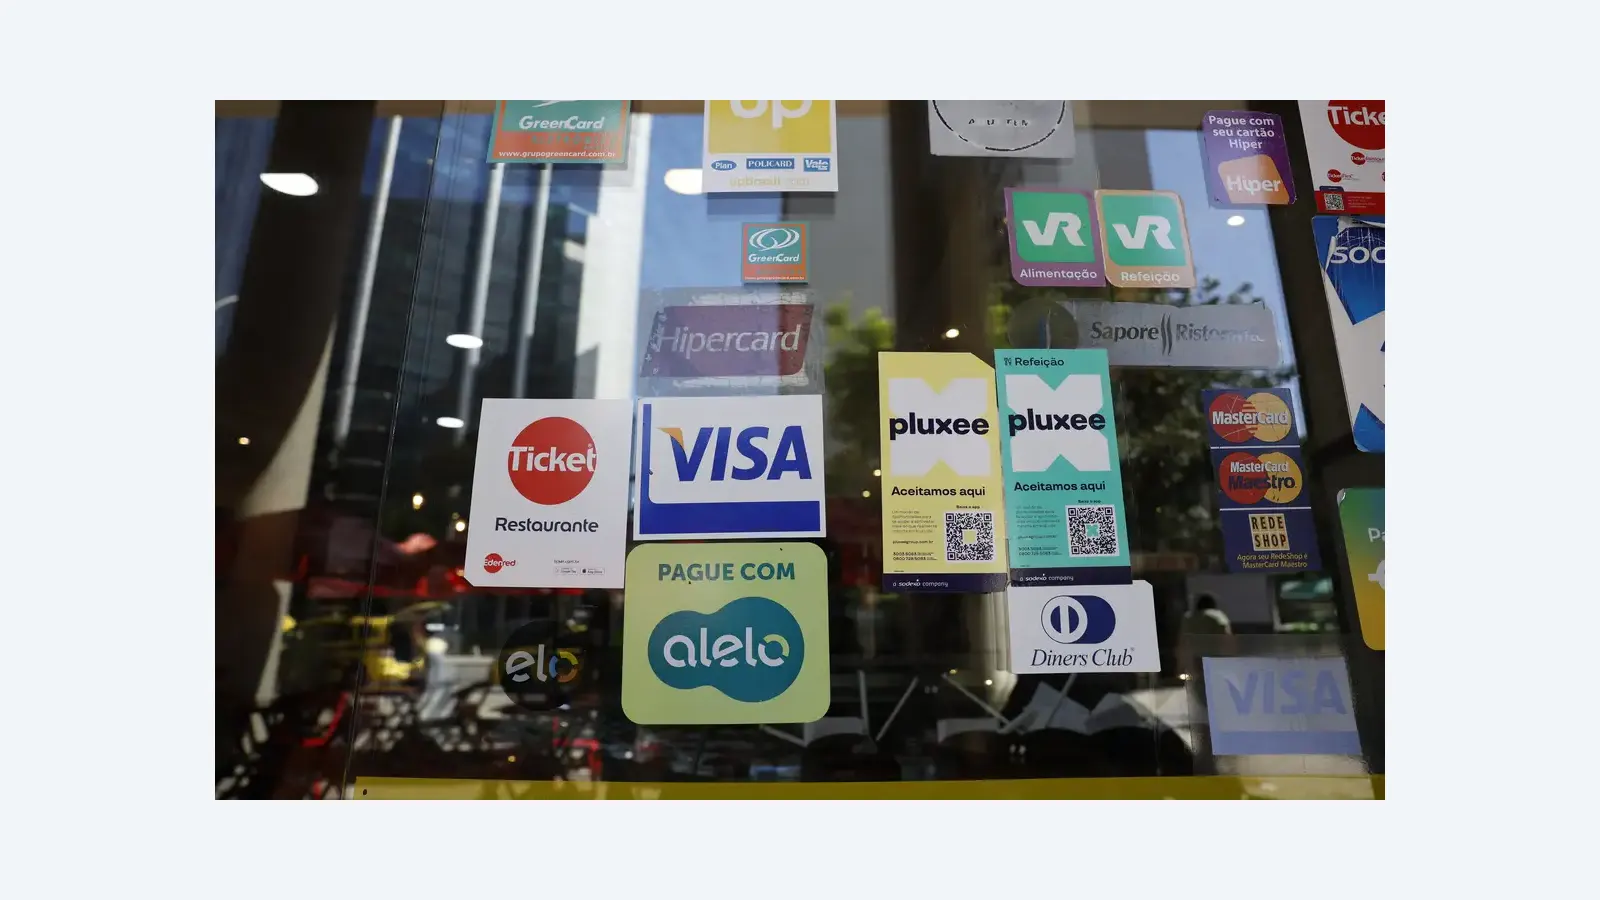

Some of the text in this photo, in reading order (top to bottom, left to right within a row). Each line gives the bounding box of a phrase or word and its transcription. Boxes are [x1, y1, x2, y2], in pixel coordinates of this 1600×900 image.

[518, 115, 605, 130] GreenCard
[1208, 115, 1274, 128] Pague com
[1213, 128, 1275, 138] seu cartão
[1229, 139, 1263, 150] Hiper
[748, 159, 793, 168] POLICARD
[1226, 175, 1281, 195] Hiper
[748, 253, 800, 263] GreenCard
[1020, 268, 1097, 281] Alimentação
[1121, 271, 1180, 283] Refeição
[1091, 321, 1159, 342] Sapore
[651, 324, 801, 360] Hipercard
[1014, 357, 1065, 368] Refeição
[1008, 408, 1106, 436] pluxee
[1212, 411, 1289, 425] MasterCard
[889, 412, 989, 441] pluxee
[508, 444, 597, 473] Ticket
[657, 425, 812, 482] VISA
[1230, 461, 1289, 473] MasterCard
[1014, 481, 1106, 493] Aceitamos aqui
[1228, 475, 1296, 491] Maestro
[891, 486, 985, 499] Aceitamos aqui
[495, 517, 599, 533] Restaurante
[1251, 516, 1285, 530] REDE
[1254, 534, 1287, 548] SHOP
[484, 559, 516, 567] Edenred
[1237, 554, 1257, 562] Agora
[1270, 552, 1303, 561] RedeShop
[658, 562, 795, 582] PAGUE COM
[1242, 561, 1279, 569] MasterCard
[663, 627, 790, 668] alelo
[505, 644, 579, 683] elo
[1031, 648, 1133, 667] Diners Club
[1225, 669, 1348, 715] VISA
